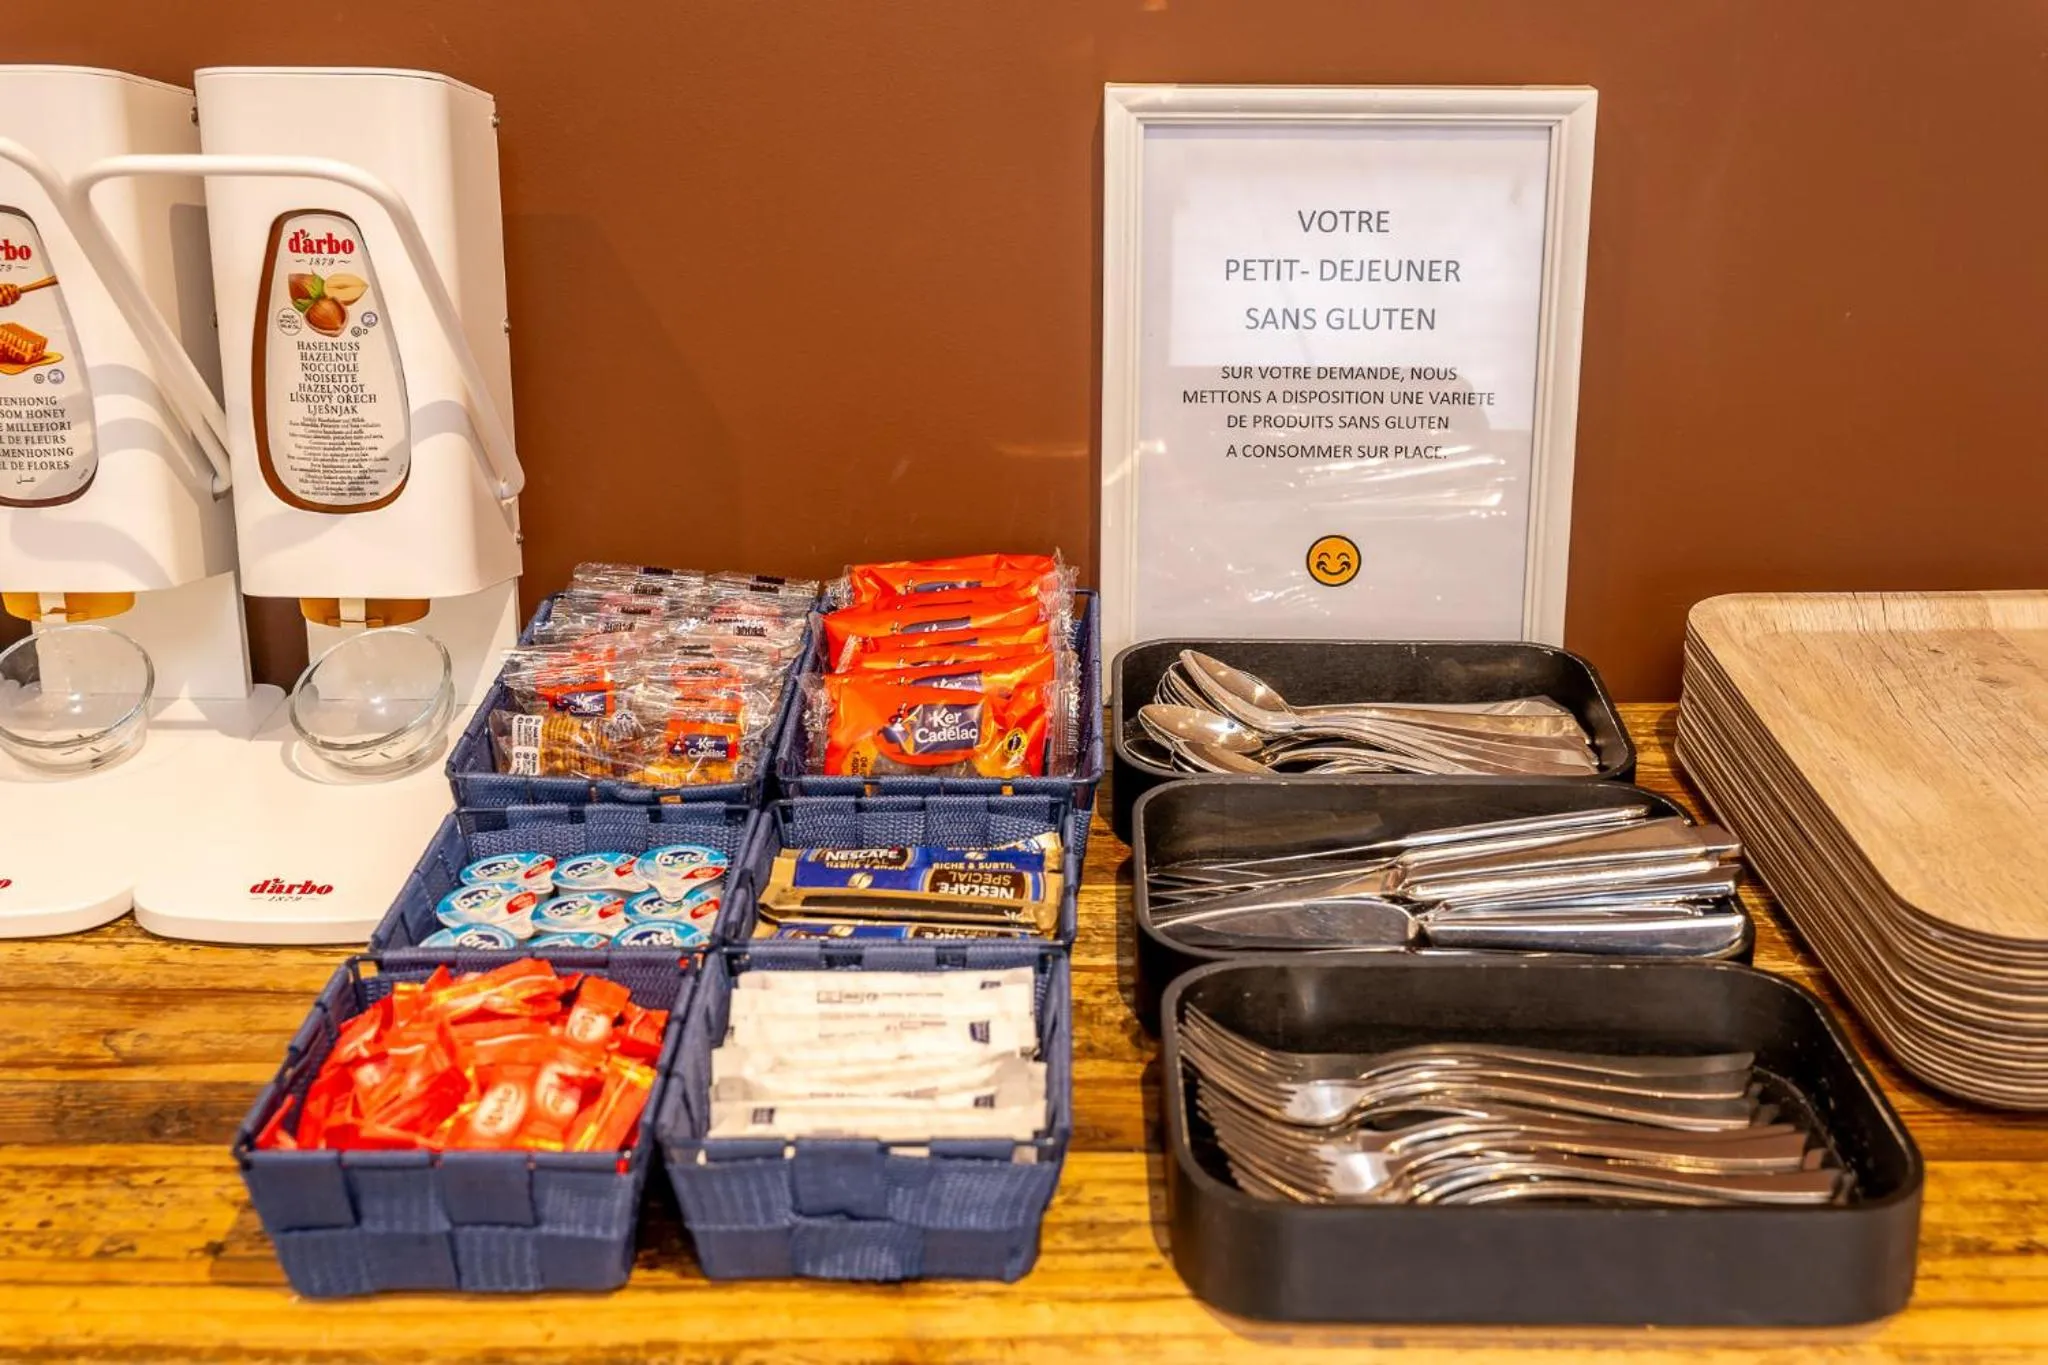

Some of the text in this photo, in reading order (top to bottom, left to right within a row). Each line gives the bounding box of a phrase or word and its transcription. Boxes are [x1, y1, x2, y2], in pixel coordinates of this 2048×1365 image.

[1297, 210, 1390, 233] VOTRE
[309, 257, 335, 266] 1879
[1225, 259, 1461, 282] PETIT- DEJEUNER
[1245, 308, 1436, 330] SANS GLUTEN
[297, 341, 360, 351] HASELNUSS
[300, 352, 358, 362] HAZELNUT
[301, 363, 359, 373] NOCCIOLE
[1221, 366, 1457, 382] SUR VOTRE DEMANDE, NOUS
[304, 373, 357, 383] NOISETTE
[298, 383, 365, 393] HAZELNOOT
[1182, 390, 1495, 405] METTONS A DISPOSITION UNE VARIETE
[25, 408, 66, 419] HONEY
[308, 404, 359, 417] LJEŠNJAK
[6, 422, 72, 432] MILLEFIORI
[1227, 415, 1449, 429] DE PRODUITS SANS GLUTEN
[8, 436, 21, 445] DE
[24, 435, 67, 445] FLEURS
[1226, 445, 1447, 459] A CONSOMMER SUR PLACE.
[11, 461, 24, 470] DE
[28, 460, 70, 470] FLORES
[930, 707, 962, 728] Ker
[948, 871, 1012, 886] SPECIAL
